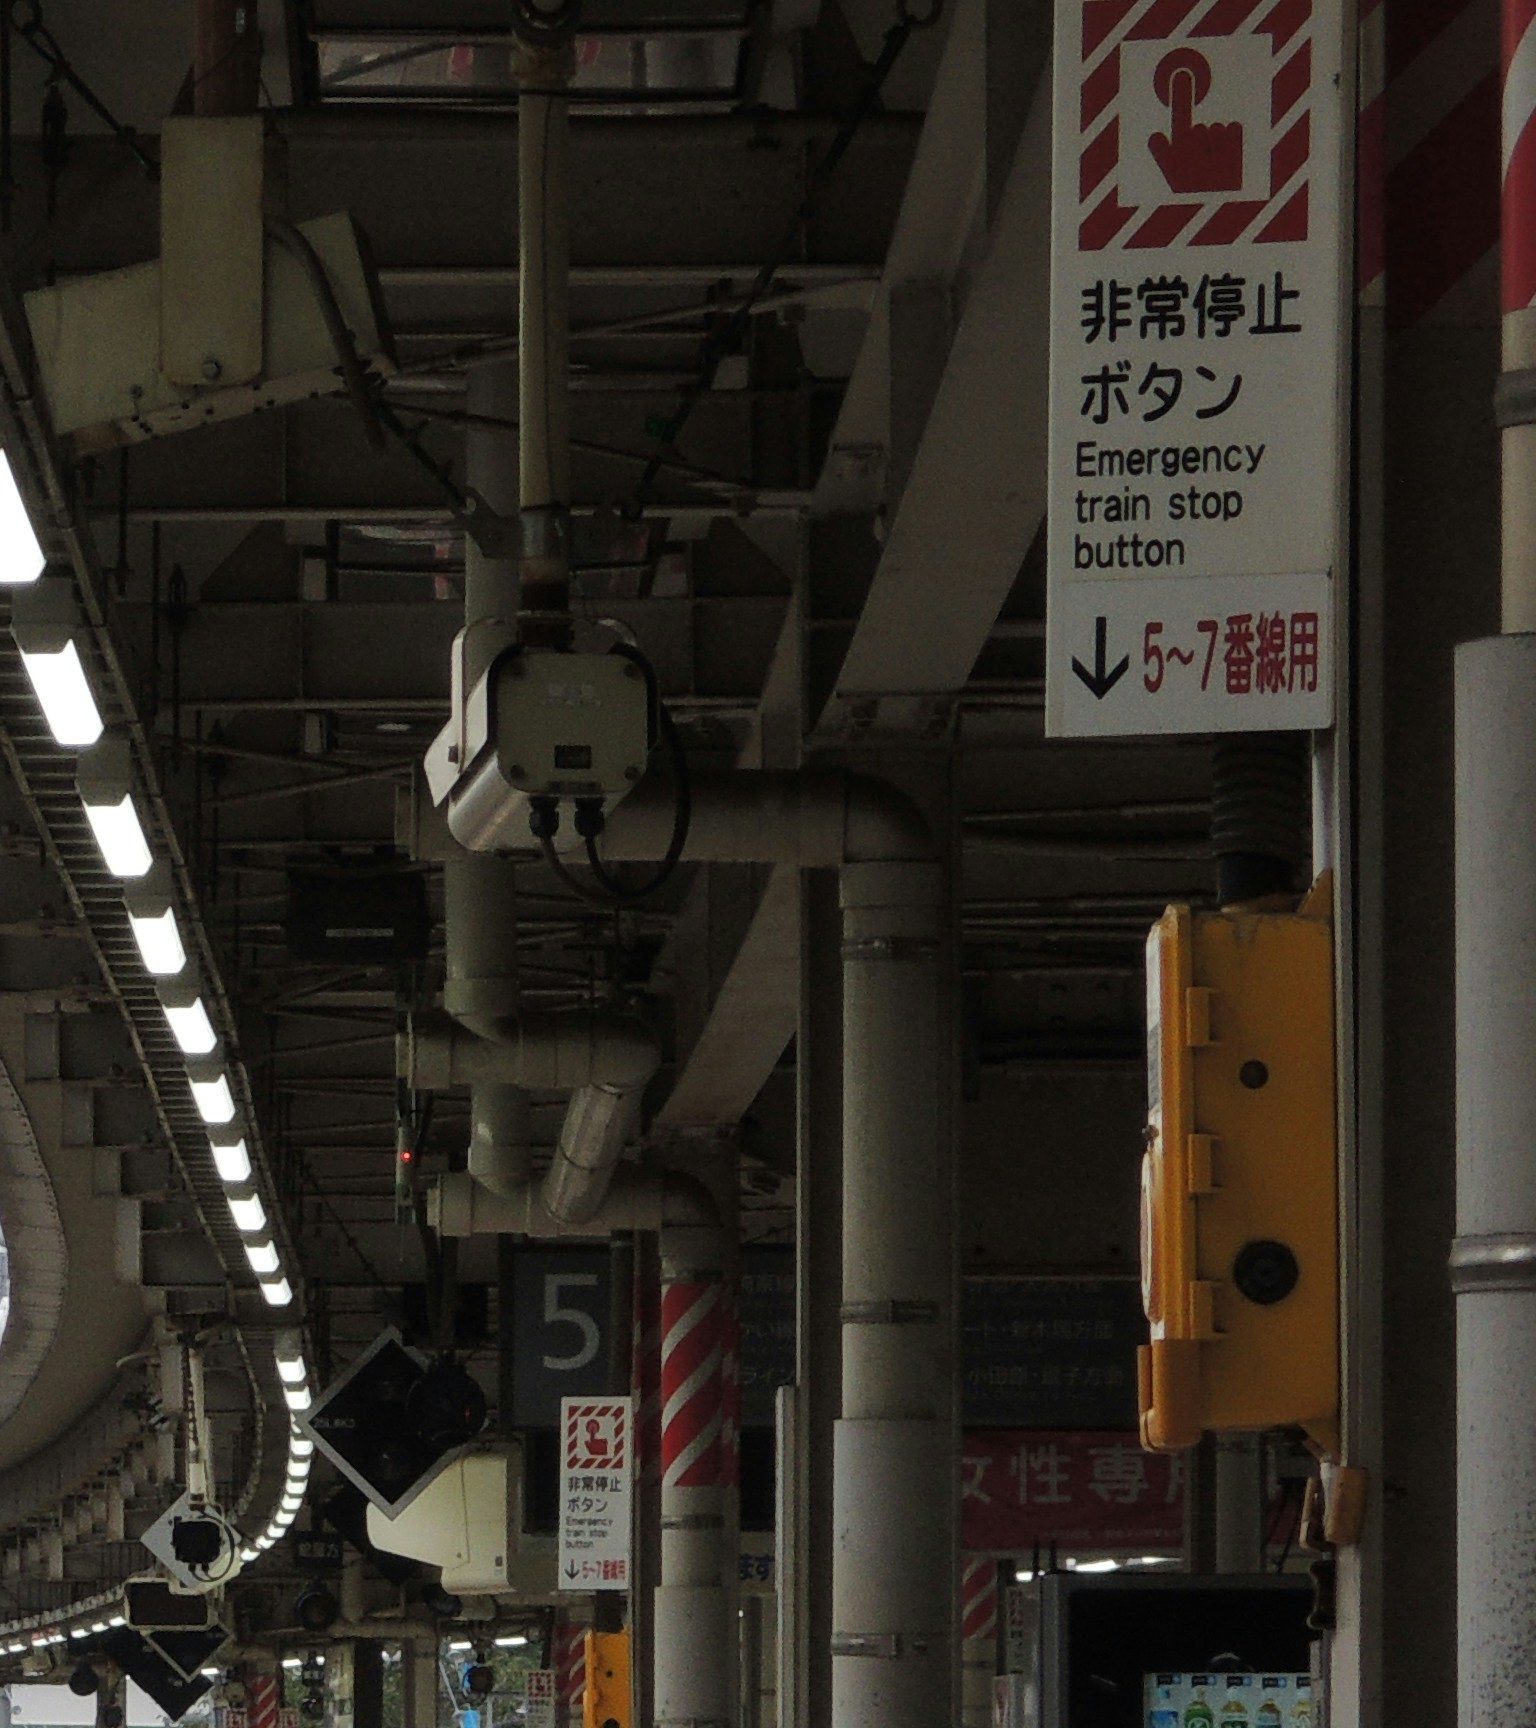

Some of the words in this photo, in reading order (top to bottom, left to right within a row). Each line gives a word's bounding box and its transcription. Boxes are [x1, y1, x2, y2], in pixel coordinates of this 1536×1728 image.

[1080, 272, 1303, 345] 非常停止
[1080, 361, 1243, 425] ボタン
[1075, 440, 1267, 478] Emergency
[1075, 488, 1151, 524] train
[1168, 486, 1244, 522] stop
[1074, 532, 1185, 569] button
[543, 1273, 601, 1371] 5
[568, 1475, 622, 1493] 非常停止
[567, 1496, 608, 1513] ボタン
